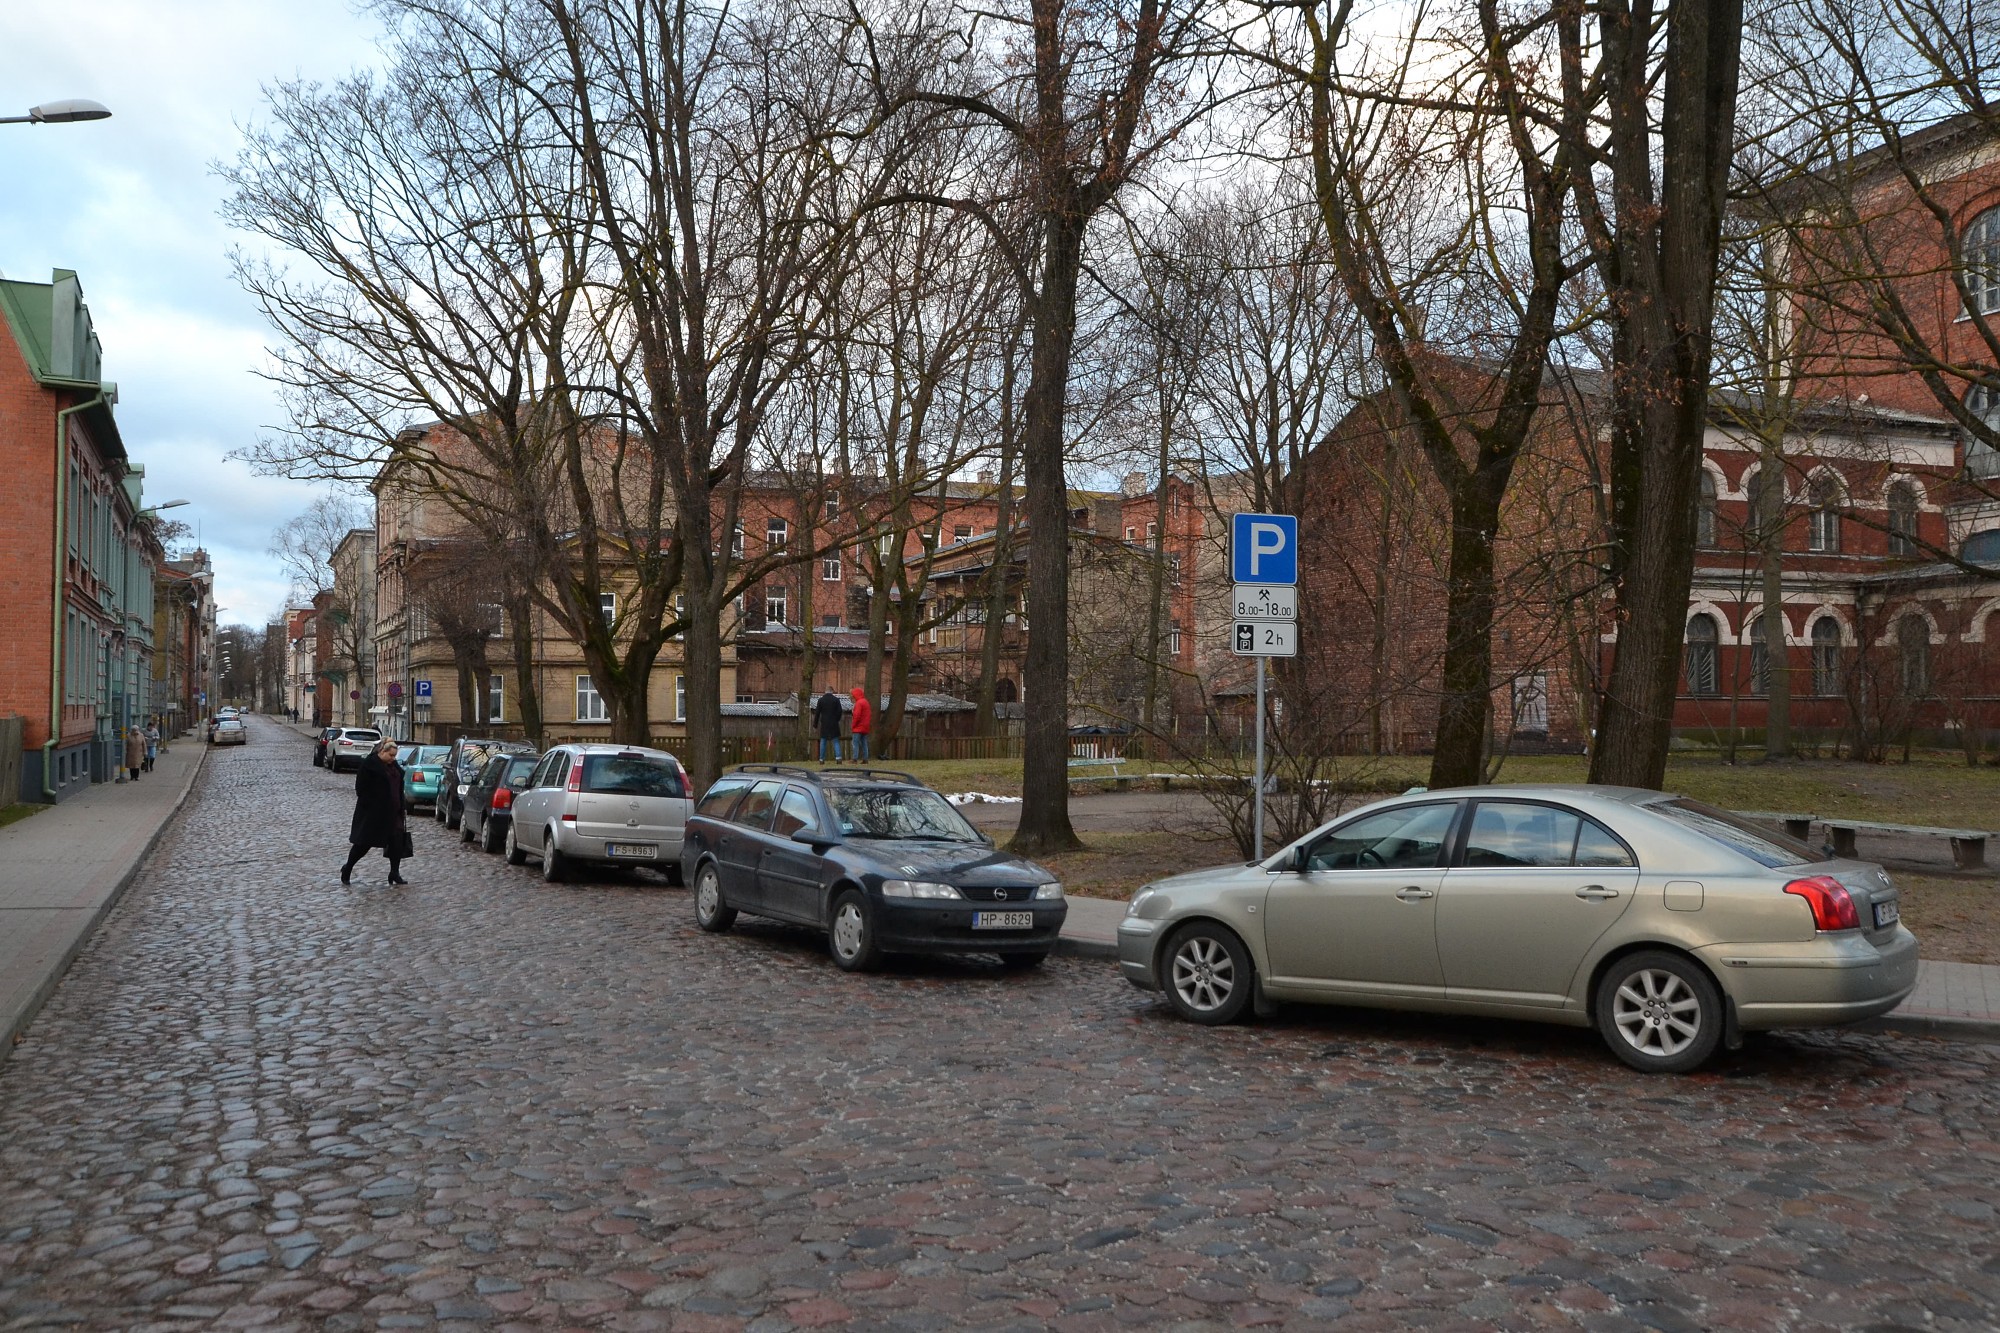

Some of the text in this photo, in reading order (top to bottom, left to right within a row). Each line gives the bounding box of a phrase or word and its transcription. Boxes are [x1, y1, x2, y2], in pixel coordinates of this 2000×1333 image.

[1251, 522, 1286, 576] P
[1238, 602, 1292, 616] 8.00-18.00
[420, 682, 430, 695] P
[981, 913, 1031, 926] HP-8629
